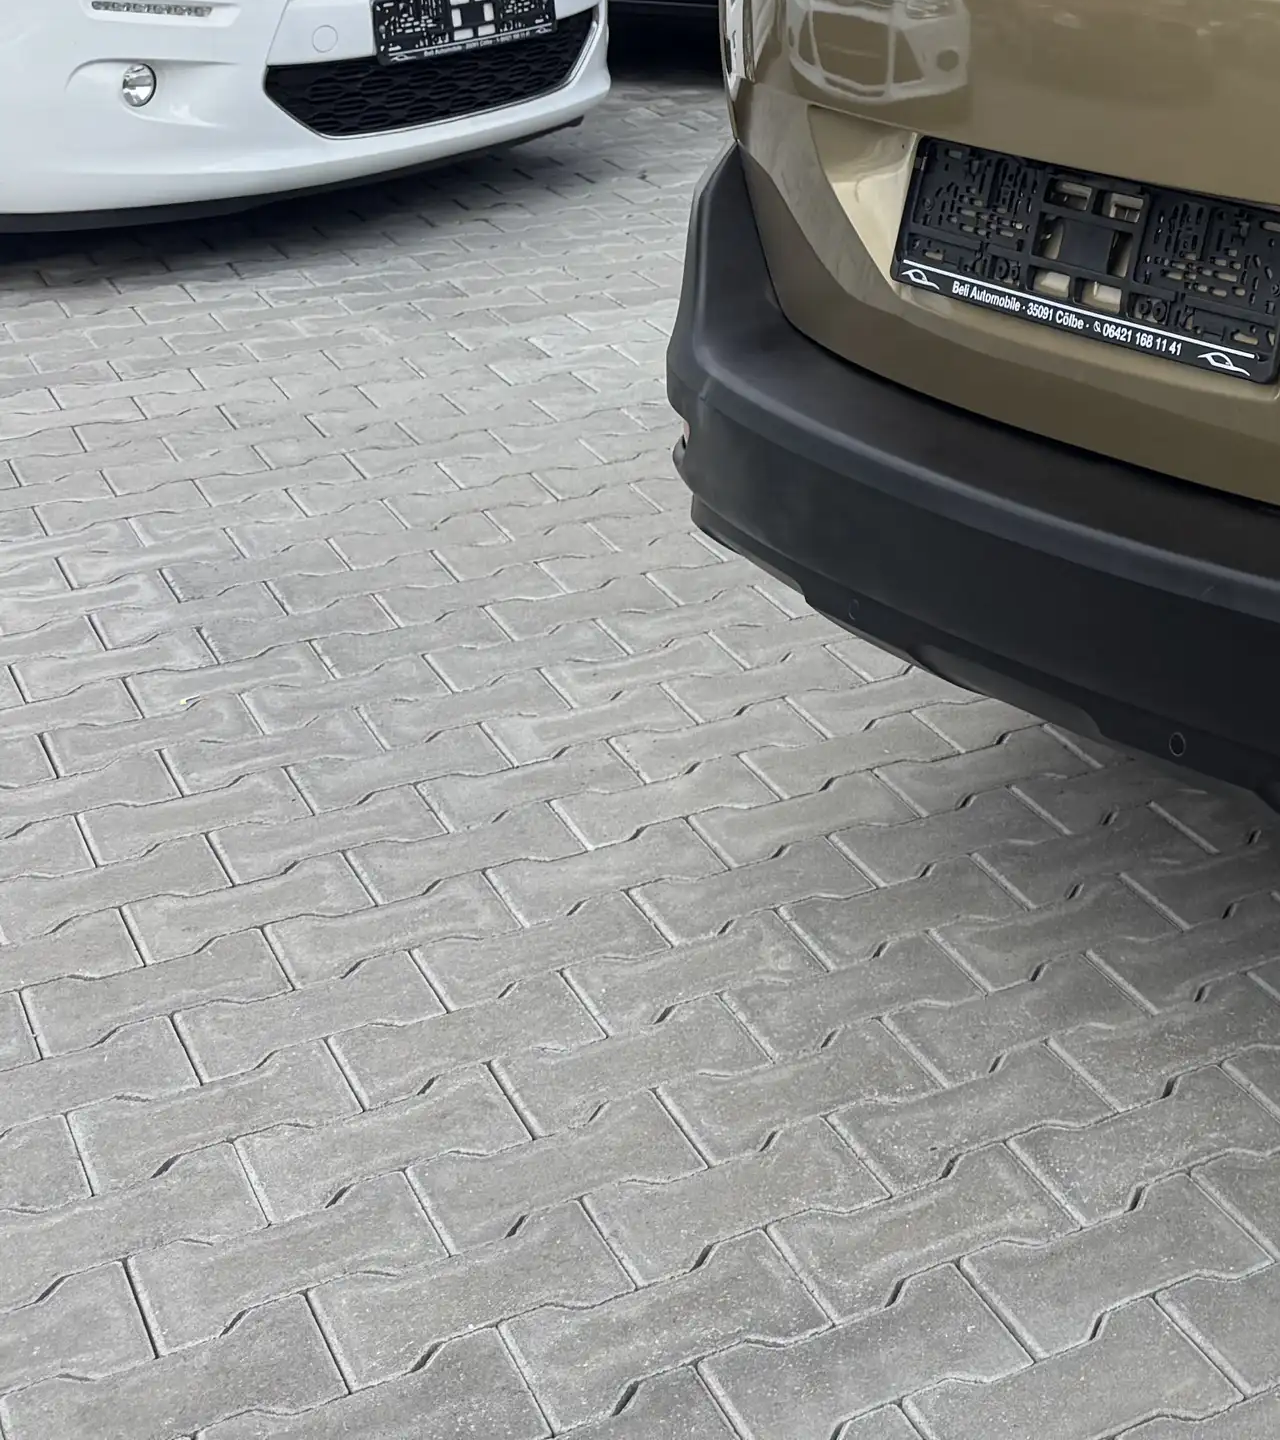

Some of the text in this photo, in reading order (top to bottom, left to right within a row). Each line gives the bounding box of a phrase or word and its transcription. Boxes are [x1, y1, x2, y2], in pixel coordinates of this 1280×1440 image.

[951, 280, 1182, 356] Beli Automobile 35091 Cölbe 06421 168 11 41
